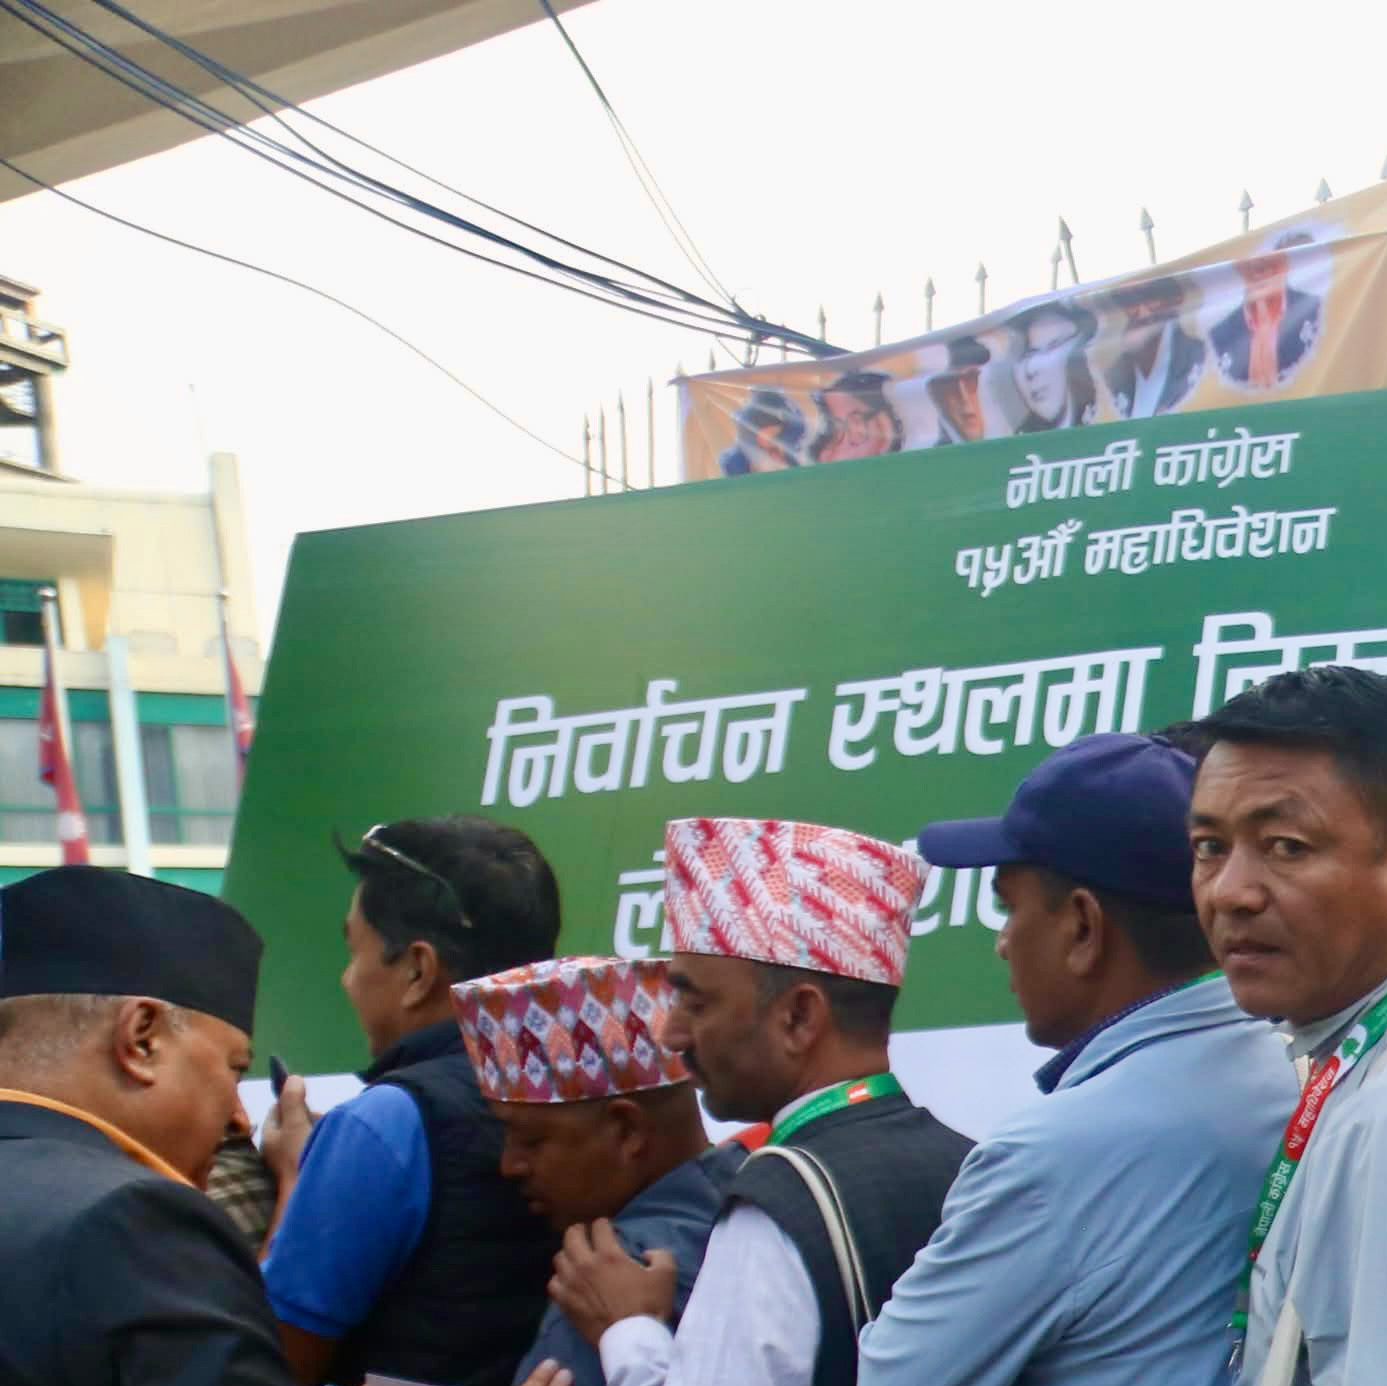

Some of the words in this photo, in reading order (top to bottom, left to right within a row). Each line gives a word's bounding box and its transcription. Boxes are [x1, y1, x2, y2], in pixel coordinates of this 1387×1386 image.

[1006, 440, 1140, 509] नेपाली
[1153, 427, 1300, 489] कांग्रेस
[1084, 506, 1337, 575] महाधिवेशन
[480, 680, 807, 808] निर्वाचन
[827, 646, 1163, 773] स्थलमा
